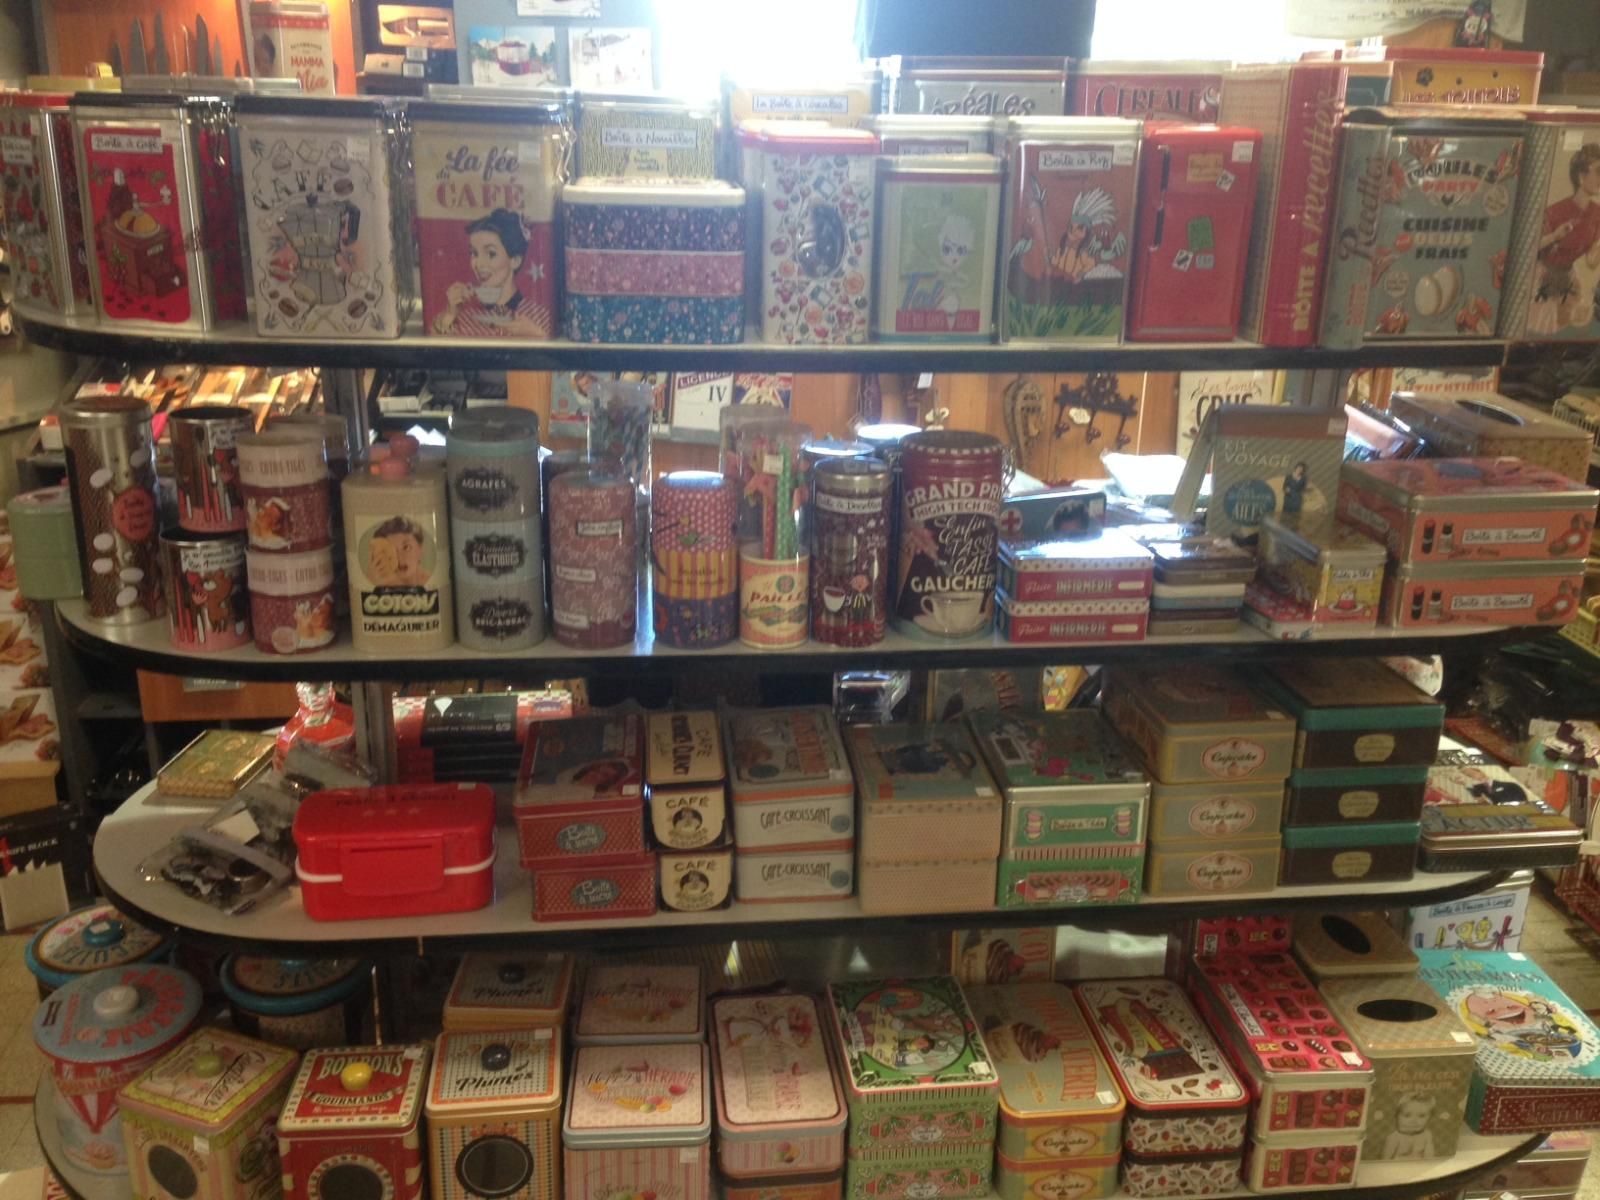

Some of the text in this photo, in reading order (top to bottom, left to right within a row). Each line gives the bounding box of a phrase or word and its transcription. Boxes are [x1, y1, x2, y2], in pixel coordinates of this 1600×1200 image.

[291, 56, 324, 68] MAMMA
[446, 145, 519, 182] La fée
[708, 383, 728, 402] IV
[1223, 451, 1290, 467] VOYAGE
[905, 479, 976, 506] GRAND
[1211, 753, 1258, 765] Cupcake
[1199, 811, 1246, 823] Cupcake
[1196, 868, 1243, 879] Cupcake
[1043, 1137, 1090, 1149] Cupcake
[1041, 1181, 1087, 1193] Cupcake
